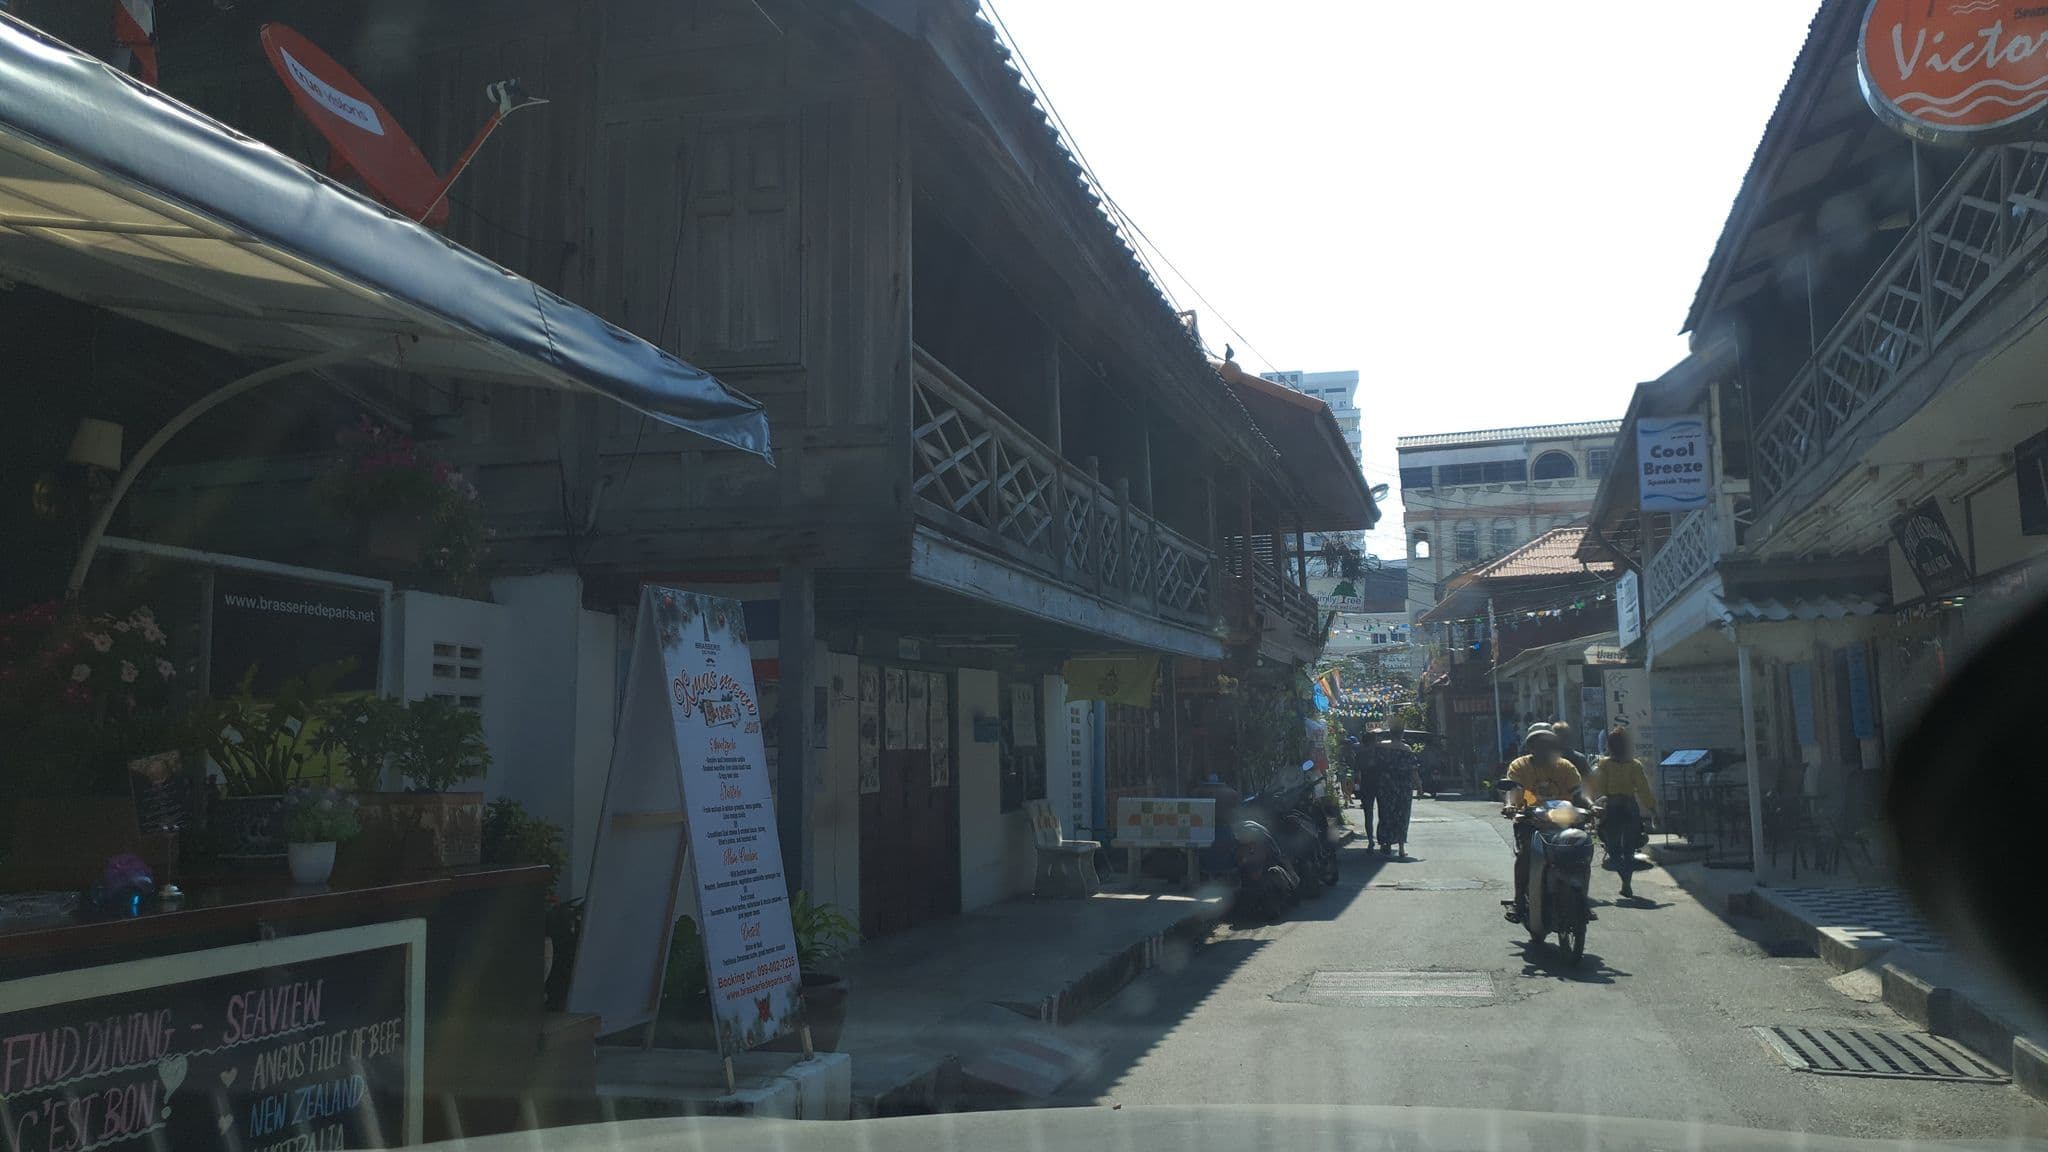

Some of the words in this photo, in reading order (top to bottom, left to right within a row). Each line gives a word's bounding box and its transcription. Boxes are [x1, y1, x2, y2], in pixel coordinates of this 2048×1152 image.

[1650, 441, 1694, 458] Cool
[1643, 462, 1703, 475] Breeze
[224, 593, 376, 622] www.brasseriedeparis.net
[718, 972, 746, 989] Booking
[223, 979, 327, 1044] SEAVIEW
[252, 1041, 306, 1092] ANGUS
[350, 1026, 368, 1059] OF
[368, 1018, 402, 1058] BEEF
[249, 1093, 288, 1138] NEW
[291, 1074, 366, 1125] ZEALAND
